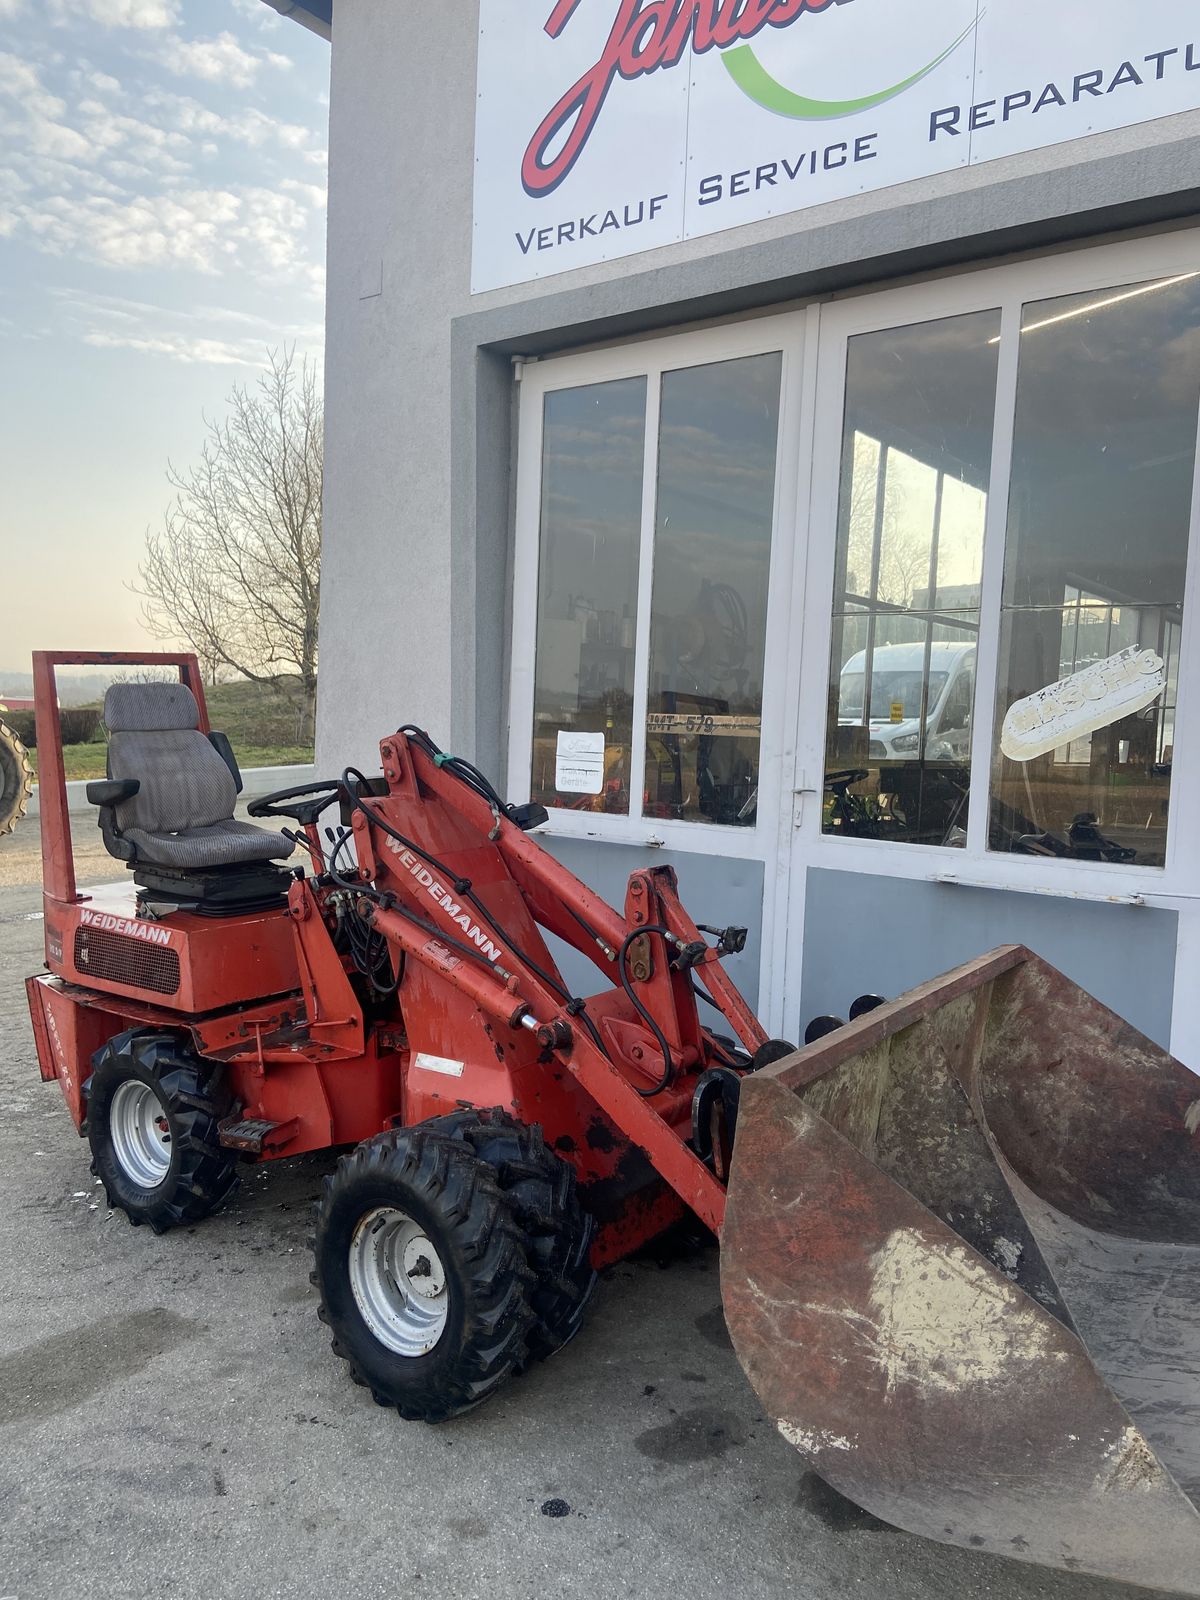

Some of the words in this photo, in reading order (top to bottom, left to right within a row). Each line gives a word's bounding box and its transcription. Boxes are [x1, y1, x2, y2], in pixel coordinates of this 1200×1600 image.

[514, 194, 669, 255] VERKAUF
[698, 132, 878, 206] SERVICE
[685, 716, 715, 733] 579
[79, 908, 172, 945] WEIDEMANN
[384, 834, 502, 962] WEIDEMANN
